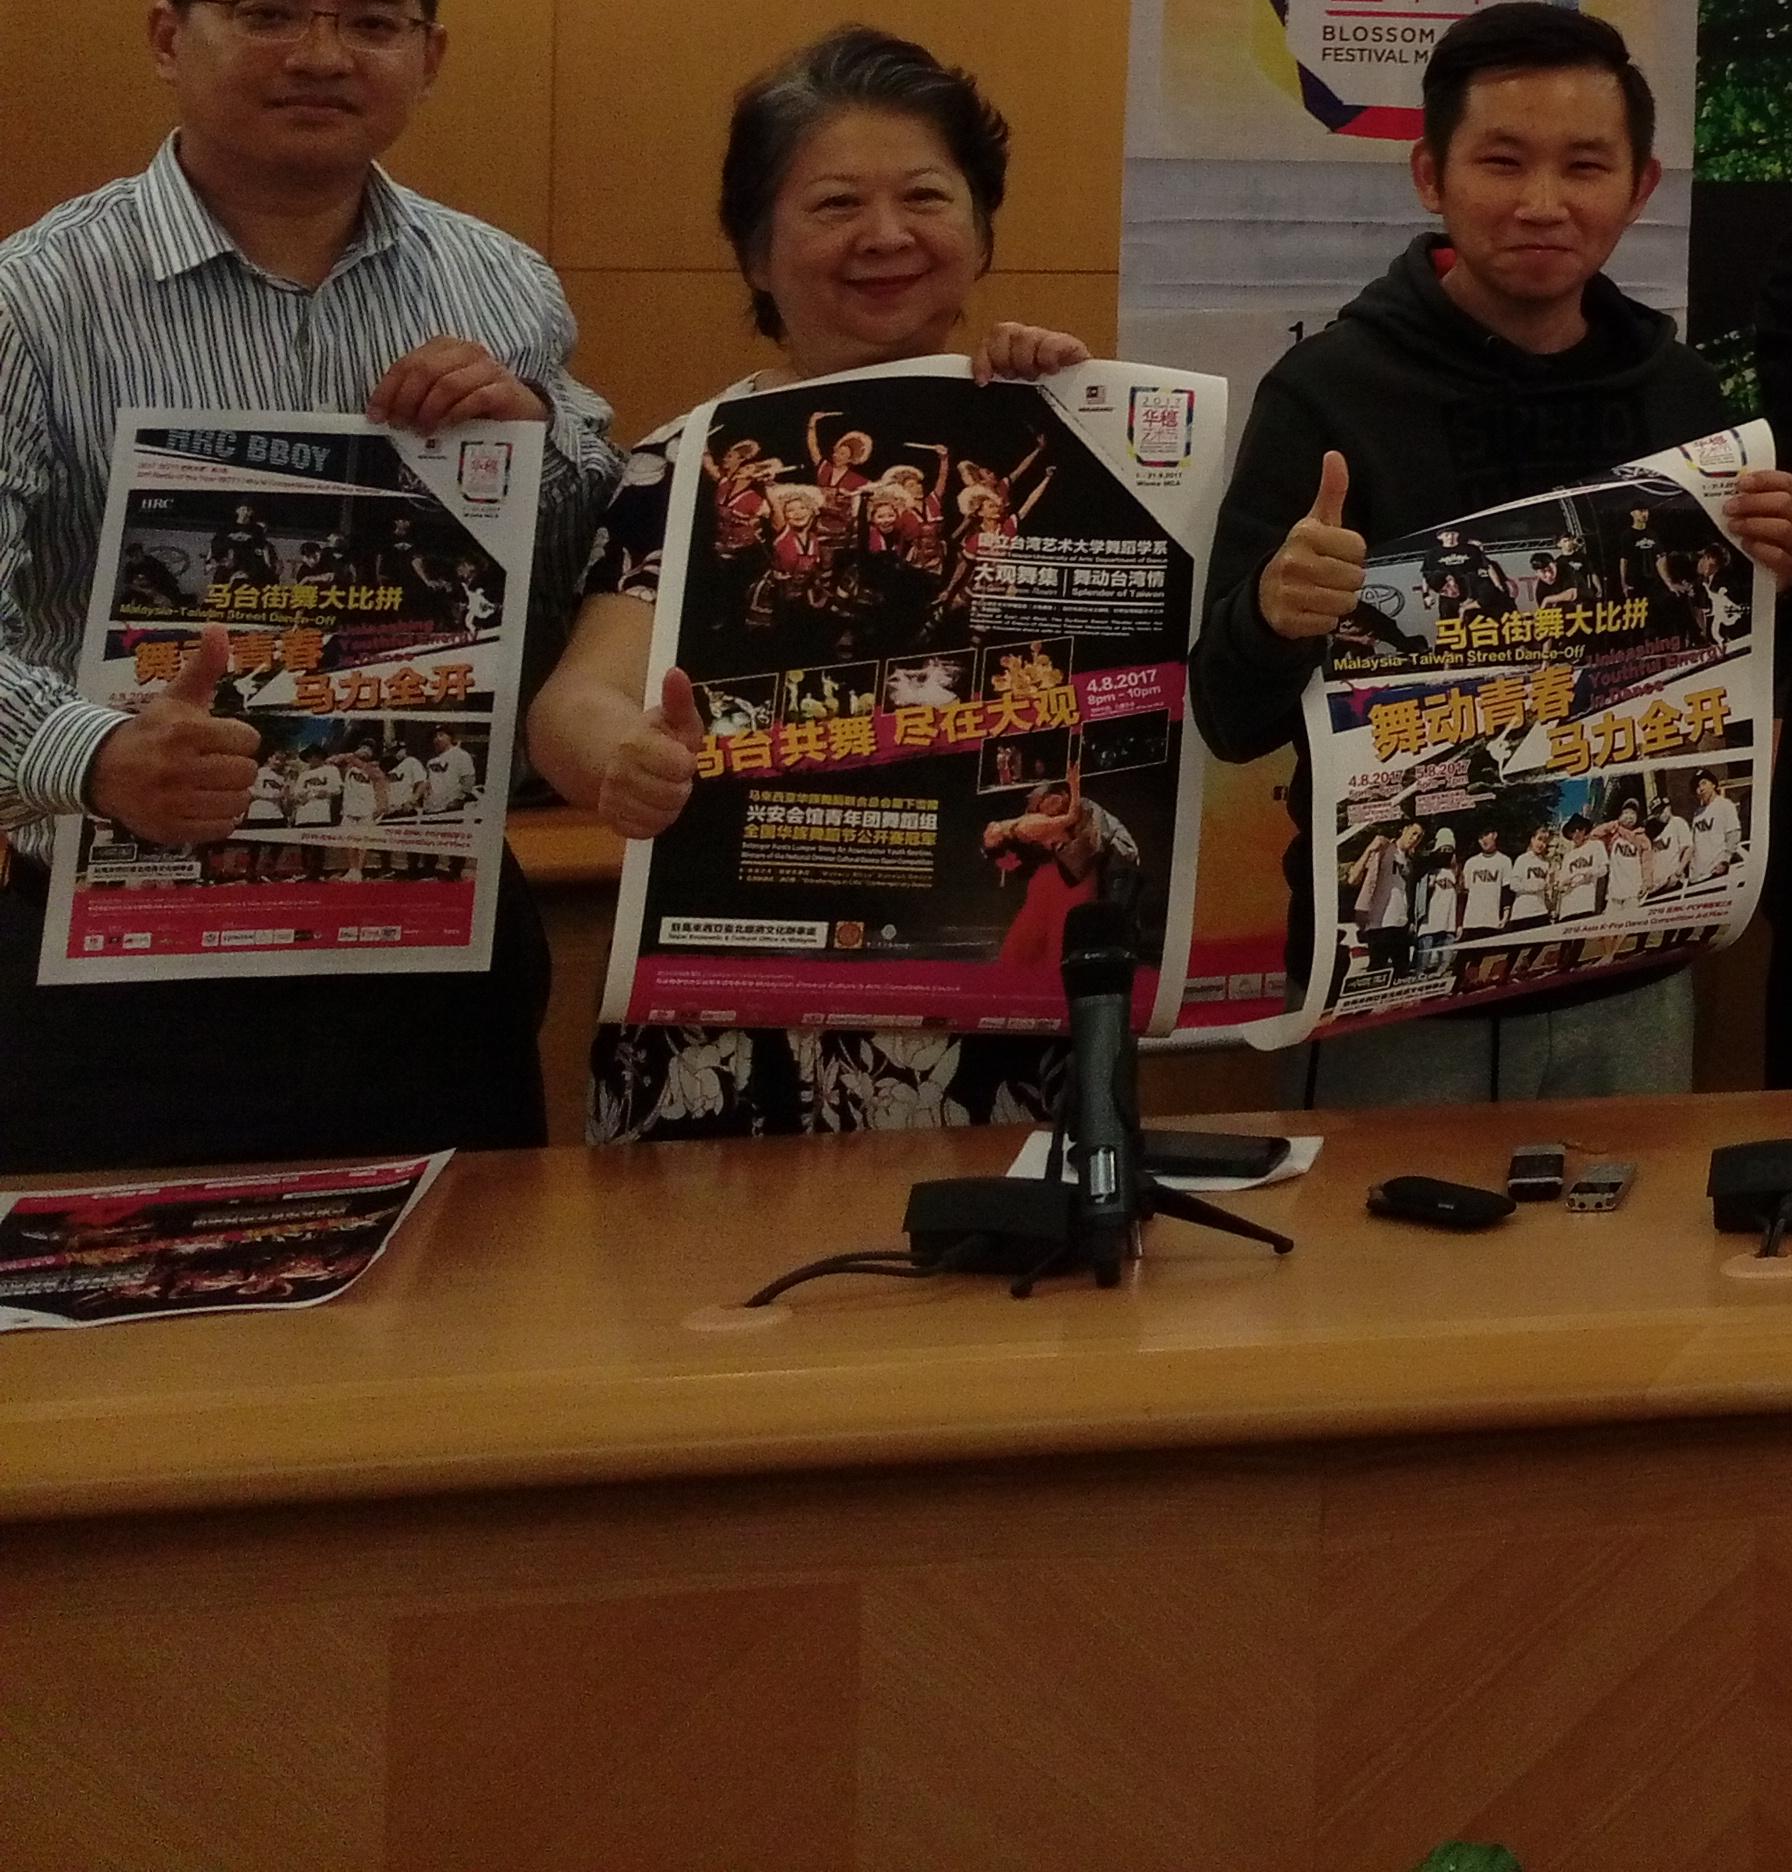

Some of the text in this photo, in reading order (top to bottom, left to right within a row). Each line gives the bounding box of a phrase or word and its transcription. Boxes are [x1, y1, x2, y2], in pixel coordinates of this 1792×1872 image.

[1322, 25, 1435, 44] BLOSSOM
[1322, 46, 1409, 65] FESTIVAL
[1435, 595, 1650, 651] 马台街舞大比拼
[1466, 649, 1513, 664] Street
[294, 662, 476, 715] 马力全开
[1086, 669, 1158, 694] 4.8.2017
[1087, 684, 1162, 706] 8pm 10pm
[893, 680, 1081, 748] 尽在大观
[1368, 662, 1576, 762] 舞动青春
[1545, 687, 1732, 778] 马力全开
